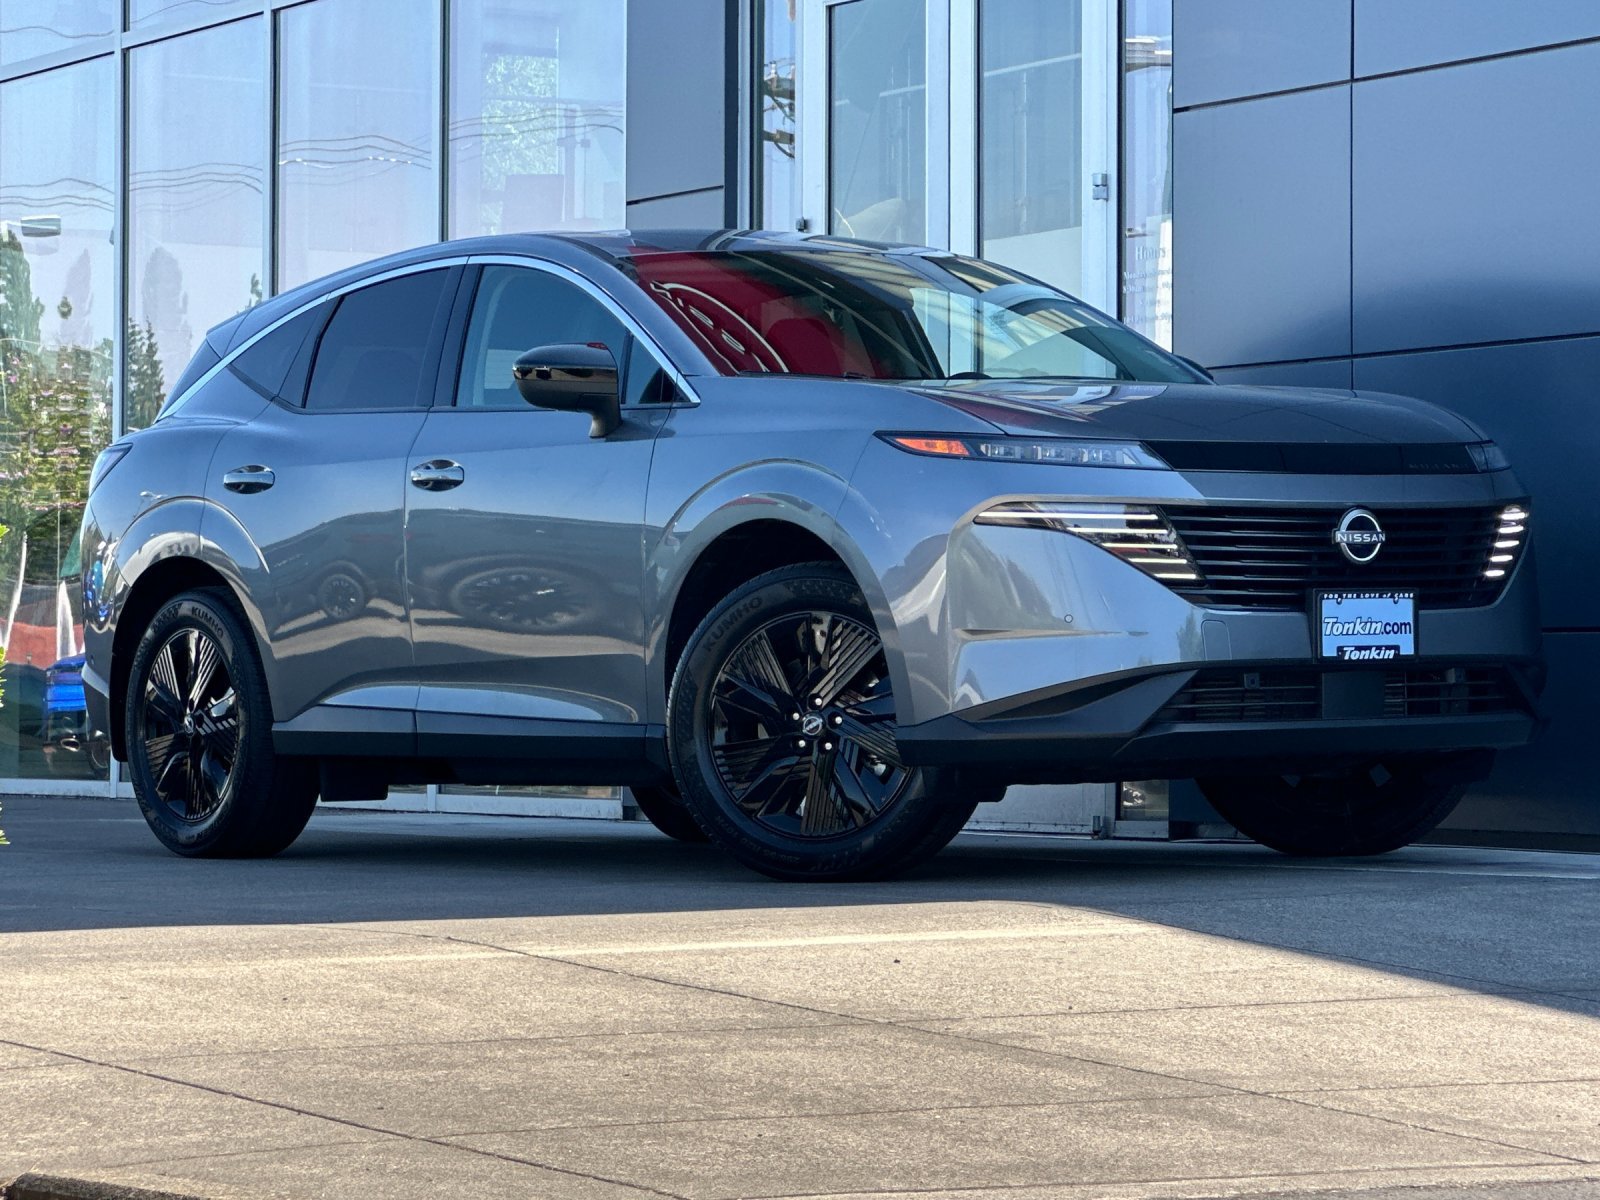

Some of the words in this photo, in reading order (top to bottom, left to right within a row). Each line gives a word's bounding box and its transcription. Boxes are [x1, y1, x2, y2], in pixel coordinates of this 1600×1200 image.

[1337, 533, 1386, 542] NISSAN
[191, 606, 225, 639] KUMHO
[702, 596, 763, 652] KUMHO
[1323, 616, 1412, 636] Tonkin.com
[1343, 646, 1395, 660] Tonkin
